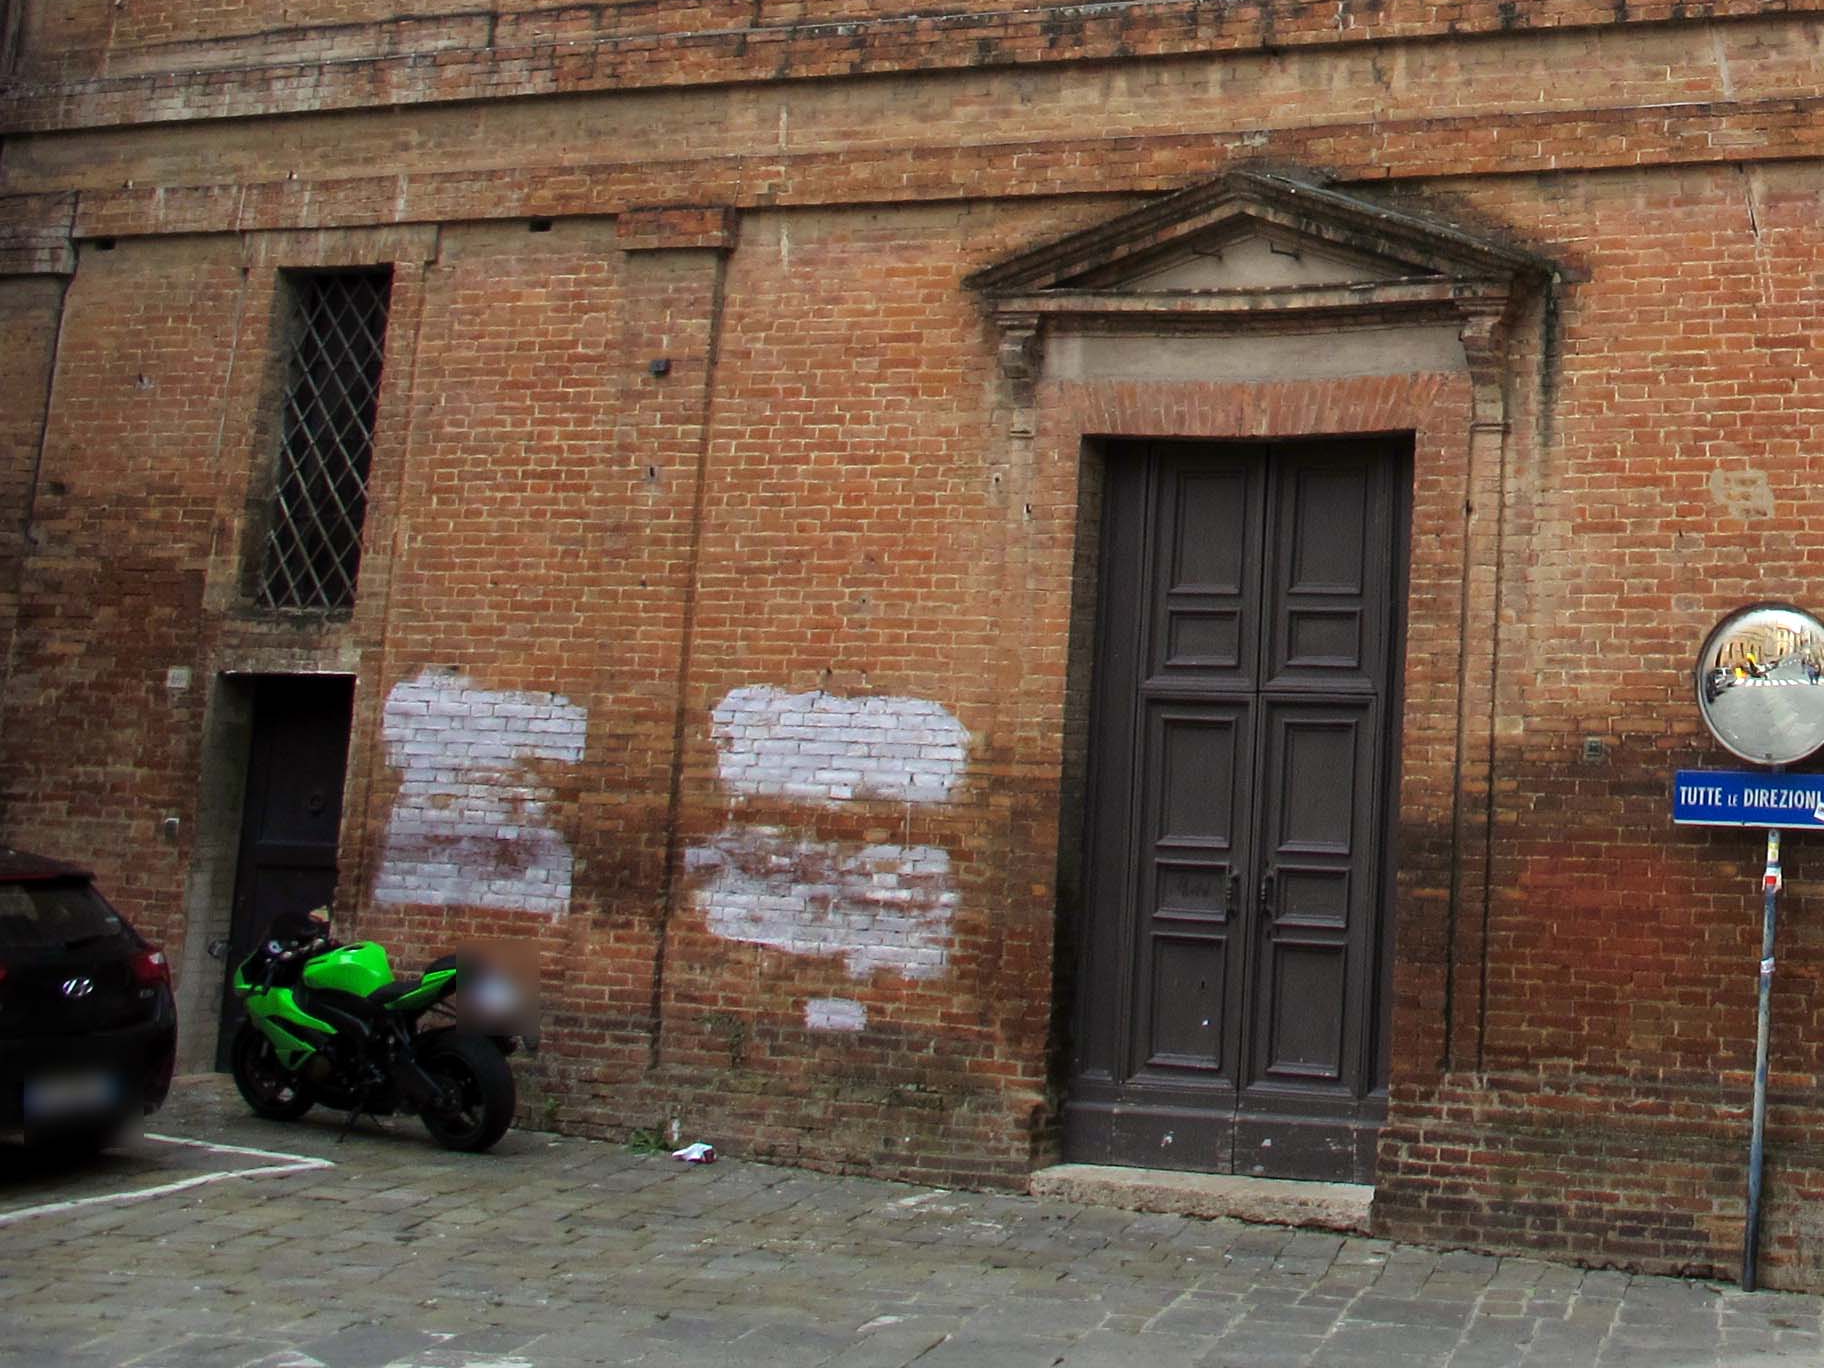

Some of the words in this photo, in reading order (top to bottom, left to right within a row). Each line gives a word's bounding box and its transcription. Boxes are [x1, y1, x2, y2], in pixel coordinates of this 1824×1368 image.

[1680, 786, 1722, 806] TUTTE
[1728, 794, 1739, 807] LE
[1744, 788, 1821, 809] DIREZIONI
